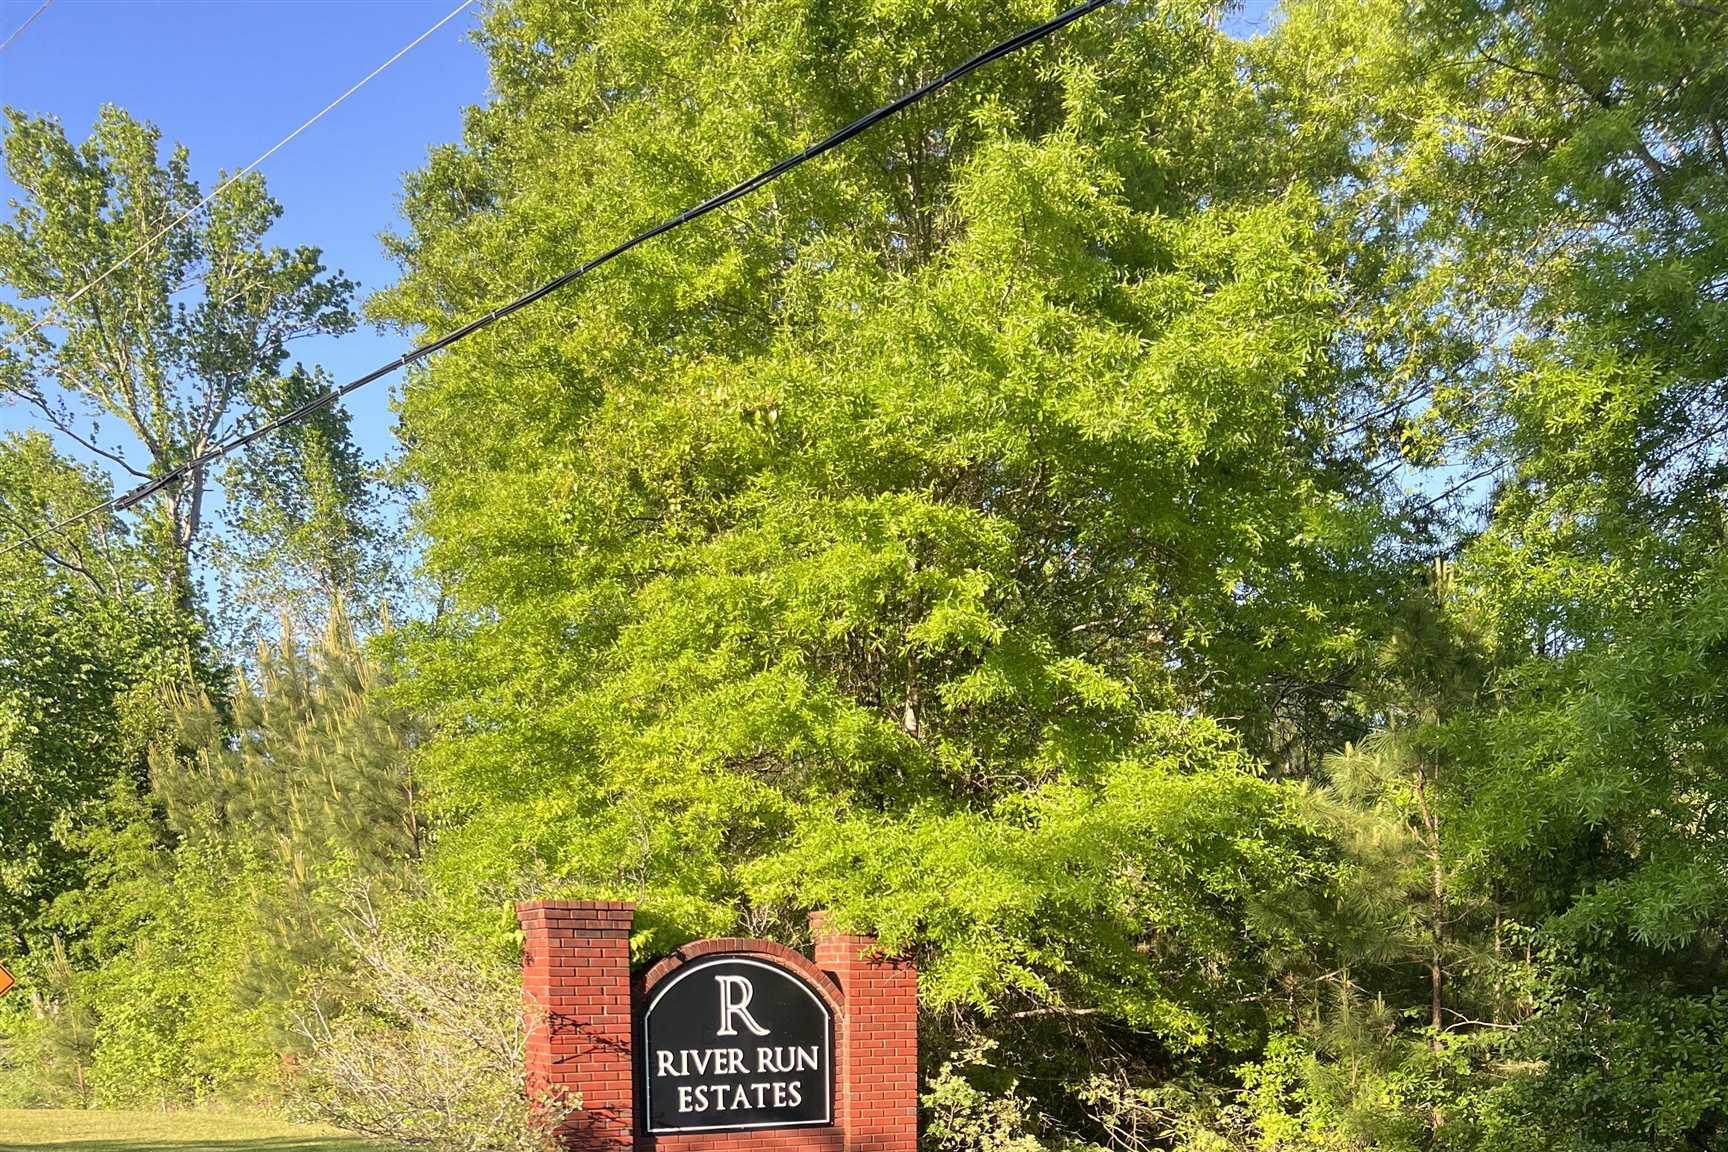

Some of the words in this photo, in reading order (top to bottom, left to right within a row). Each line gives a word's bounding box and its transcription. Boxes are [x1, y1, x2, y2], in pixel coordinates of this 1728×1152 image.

[714, 974, 771, 1037] R
[656, 1047, 751, 1077] RIVER
[756, 1045, 820, 1073] RUN
[677, 1080, 803, 1113] ESTATES
